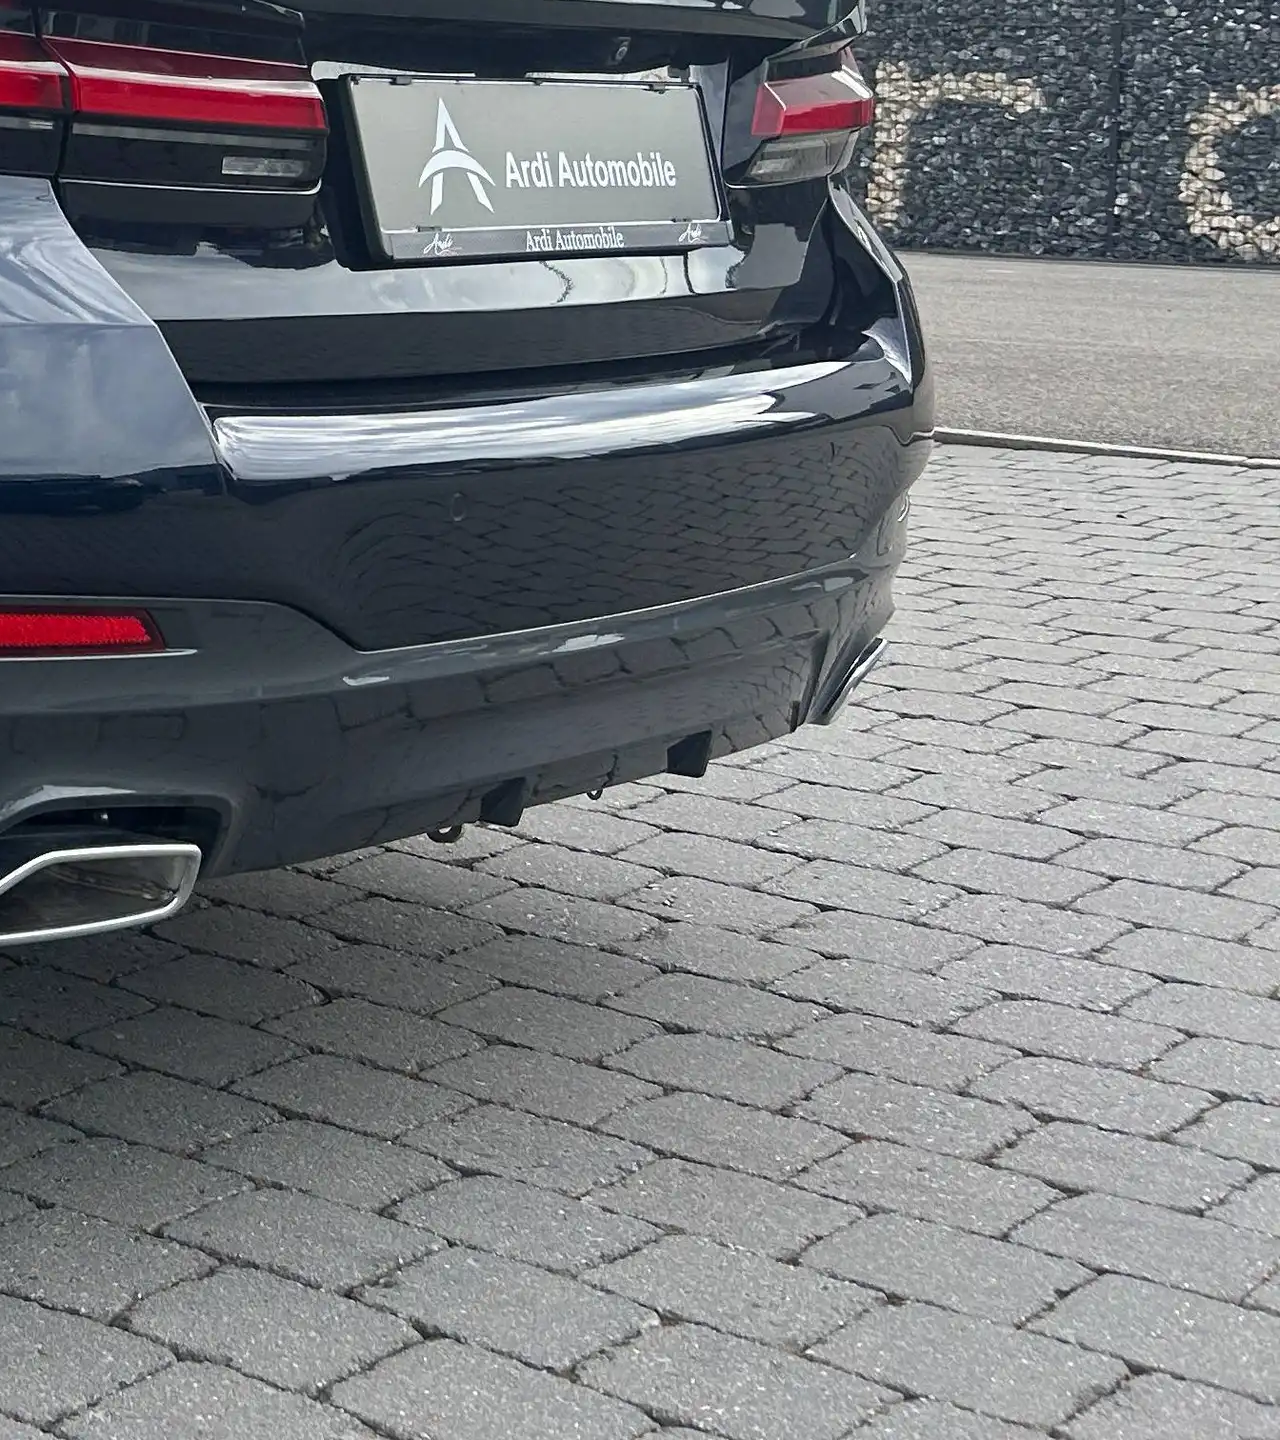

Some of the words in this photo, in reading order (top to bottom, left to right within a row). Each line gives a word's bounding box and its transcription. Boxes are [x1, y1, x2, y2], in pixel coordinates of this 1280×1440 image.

[505, 151, 554, 188] Ardi
[558, 150, 677, 188] Automobile
[526, 228, 553, 252] Ardi
[555, 225, 625, 250] Automobile
